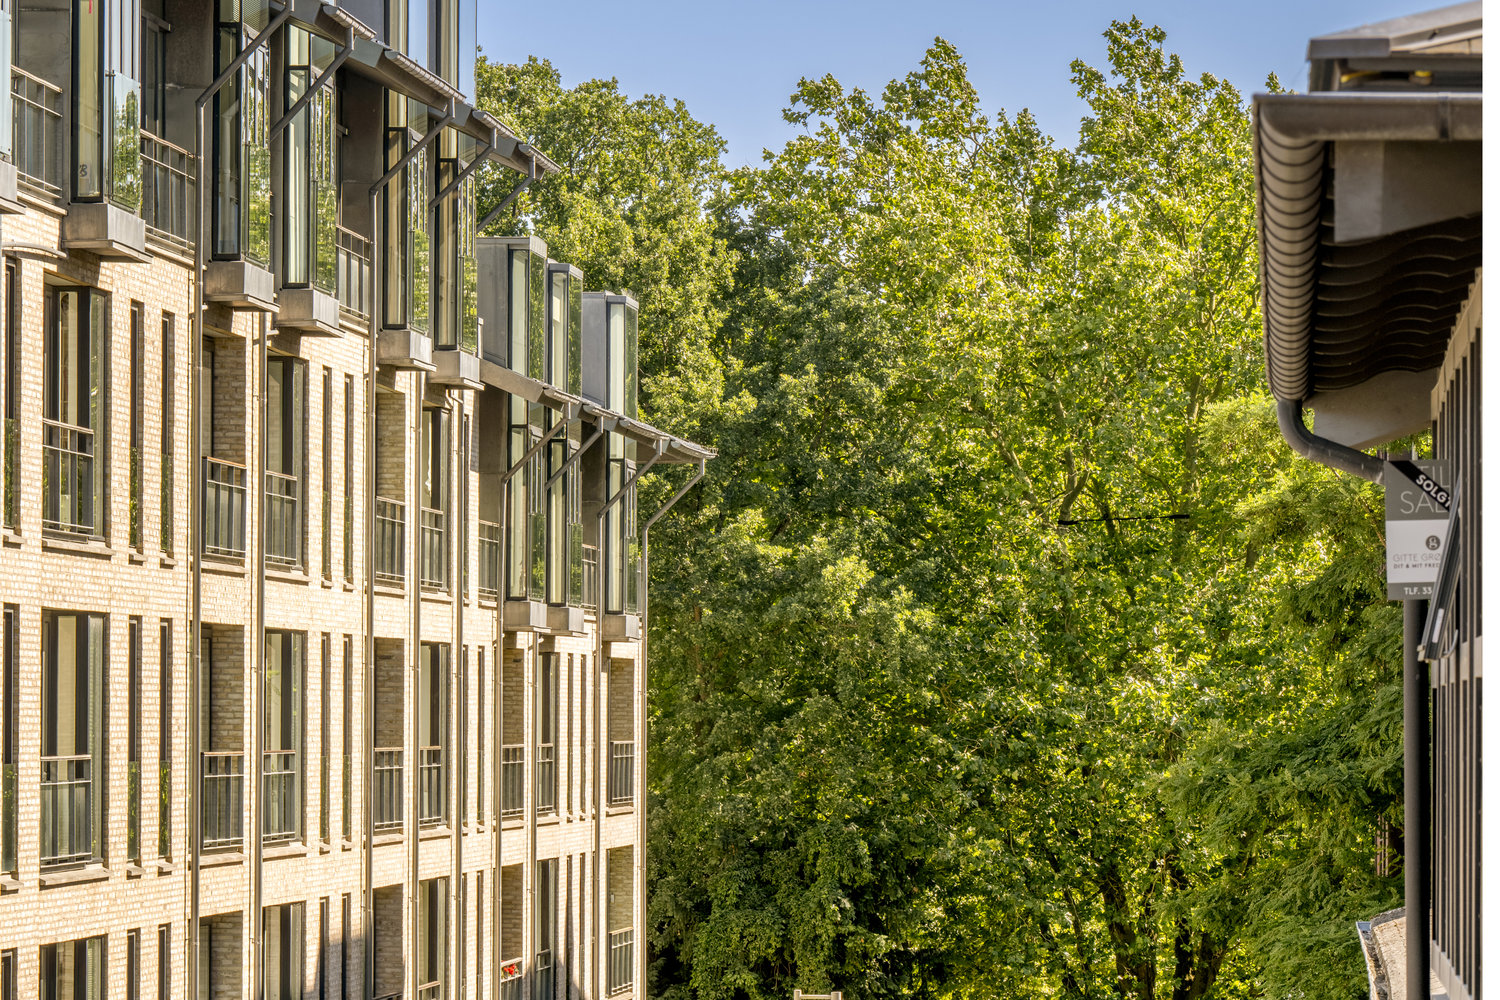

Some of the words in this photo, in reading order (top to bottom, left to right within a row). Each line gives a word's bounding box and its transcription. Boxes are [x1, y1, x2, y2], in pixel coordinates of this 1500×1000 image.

[1400, 491, 1448, 514] SAL
[1393, 553, 1417, 562] GITTE
[1421, 553, 1441, 562] GRØ
[1404, 587, 1420, 595] TLF.
